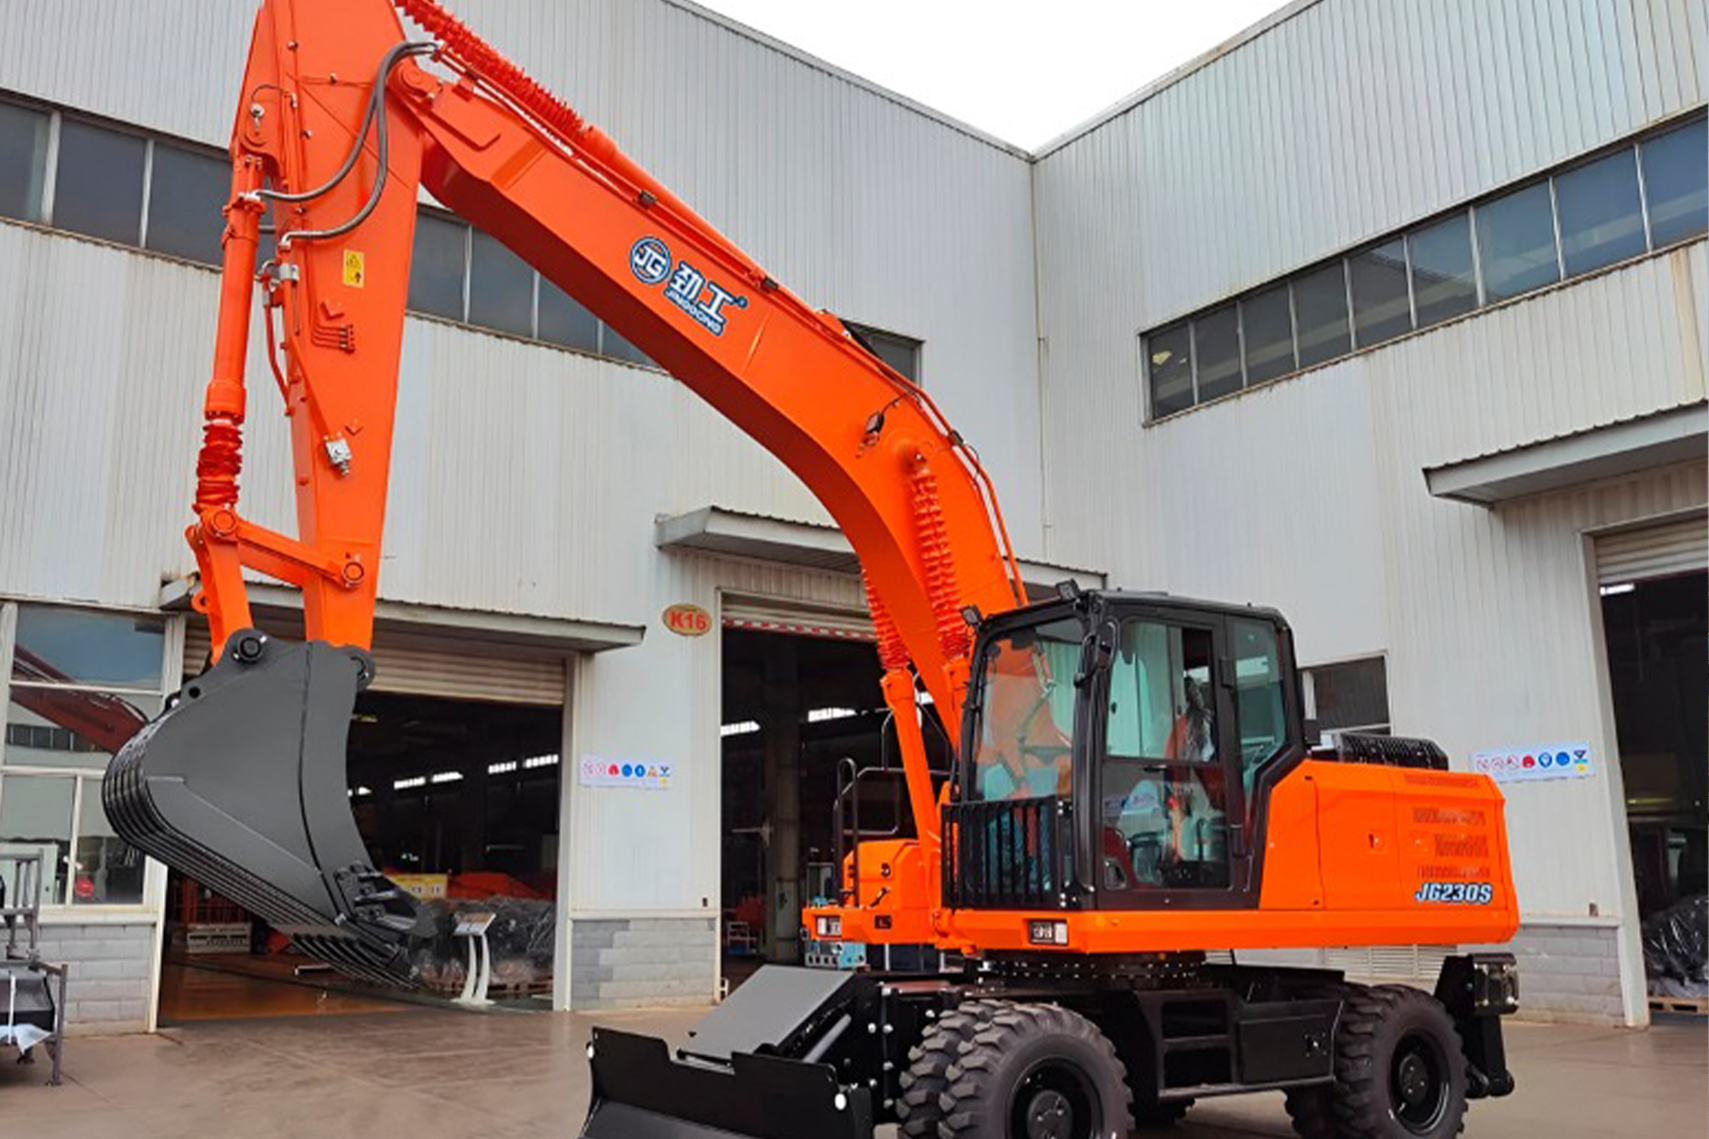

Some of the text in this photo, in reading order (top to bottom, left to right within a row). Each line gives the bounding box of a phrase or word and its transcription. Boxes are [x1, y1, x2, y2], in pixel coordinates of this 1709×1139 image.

[633, 243, 668, 280] JG
[669, 261, 734, 323] 劲工
[669, 611, 706, 630] K16
[1415, 882, 1493, 904] JG230S
